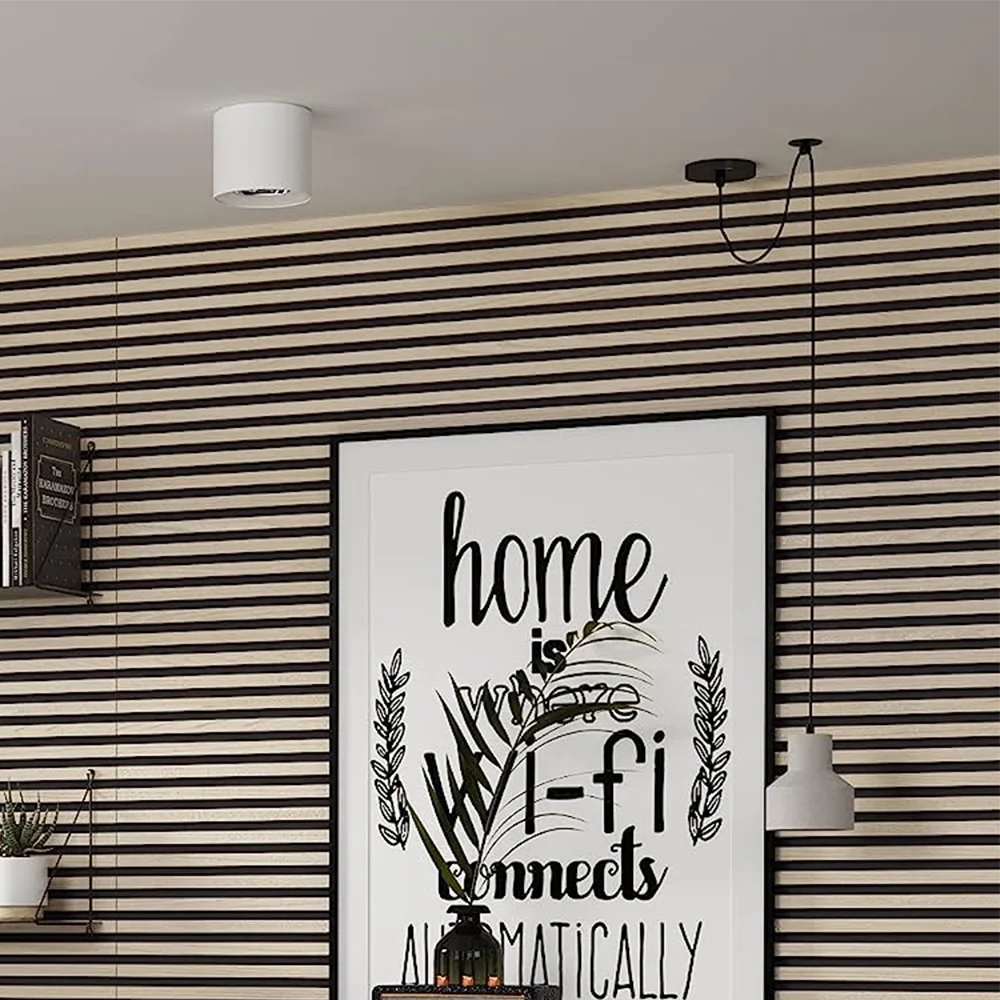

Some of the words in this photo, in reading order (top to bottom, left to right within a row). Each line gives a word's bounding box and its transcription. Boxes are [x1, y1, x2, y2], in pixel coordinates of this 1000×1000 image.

[443, 490, 668, 627] home
[531, 627, 568, 674] is
[457, 669, 642, 725] where
[438, 825, 669, 901] connects
